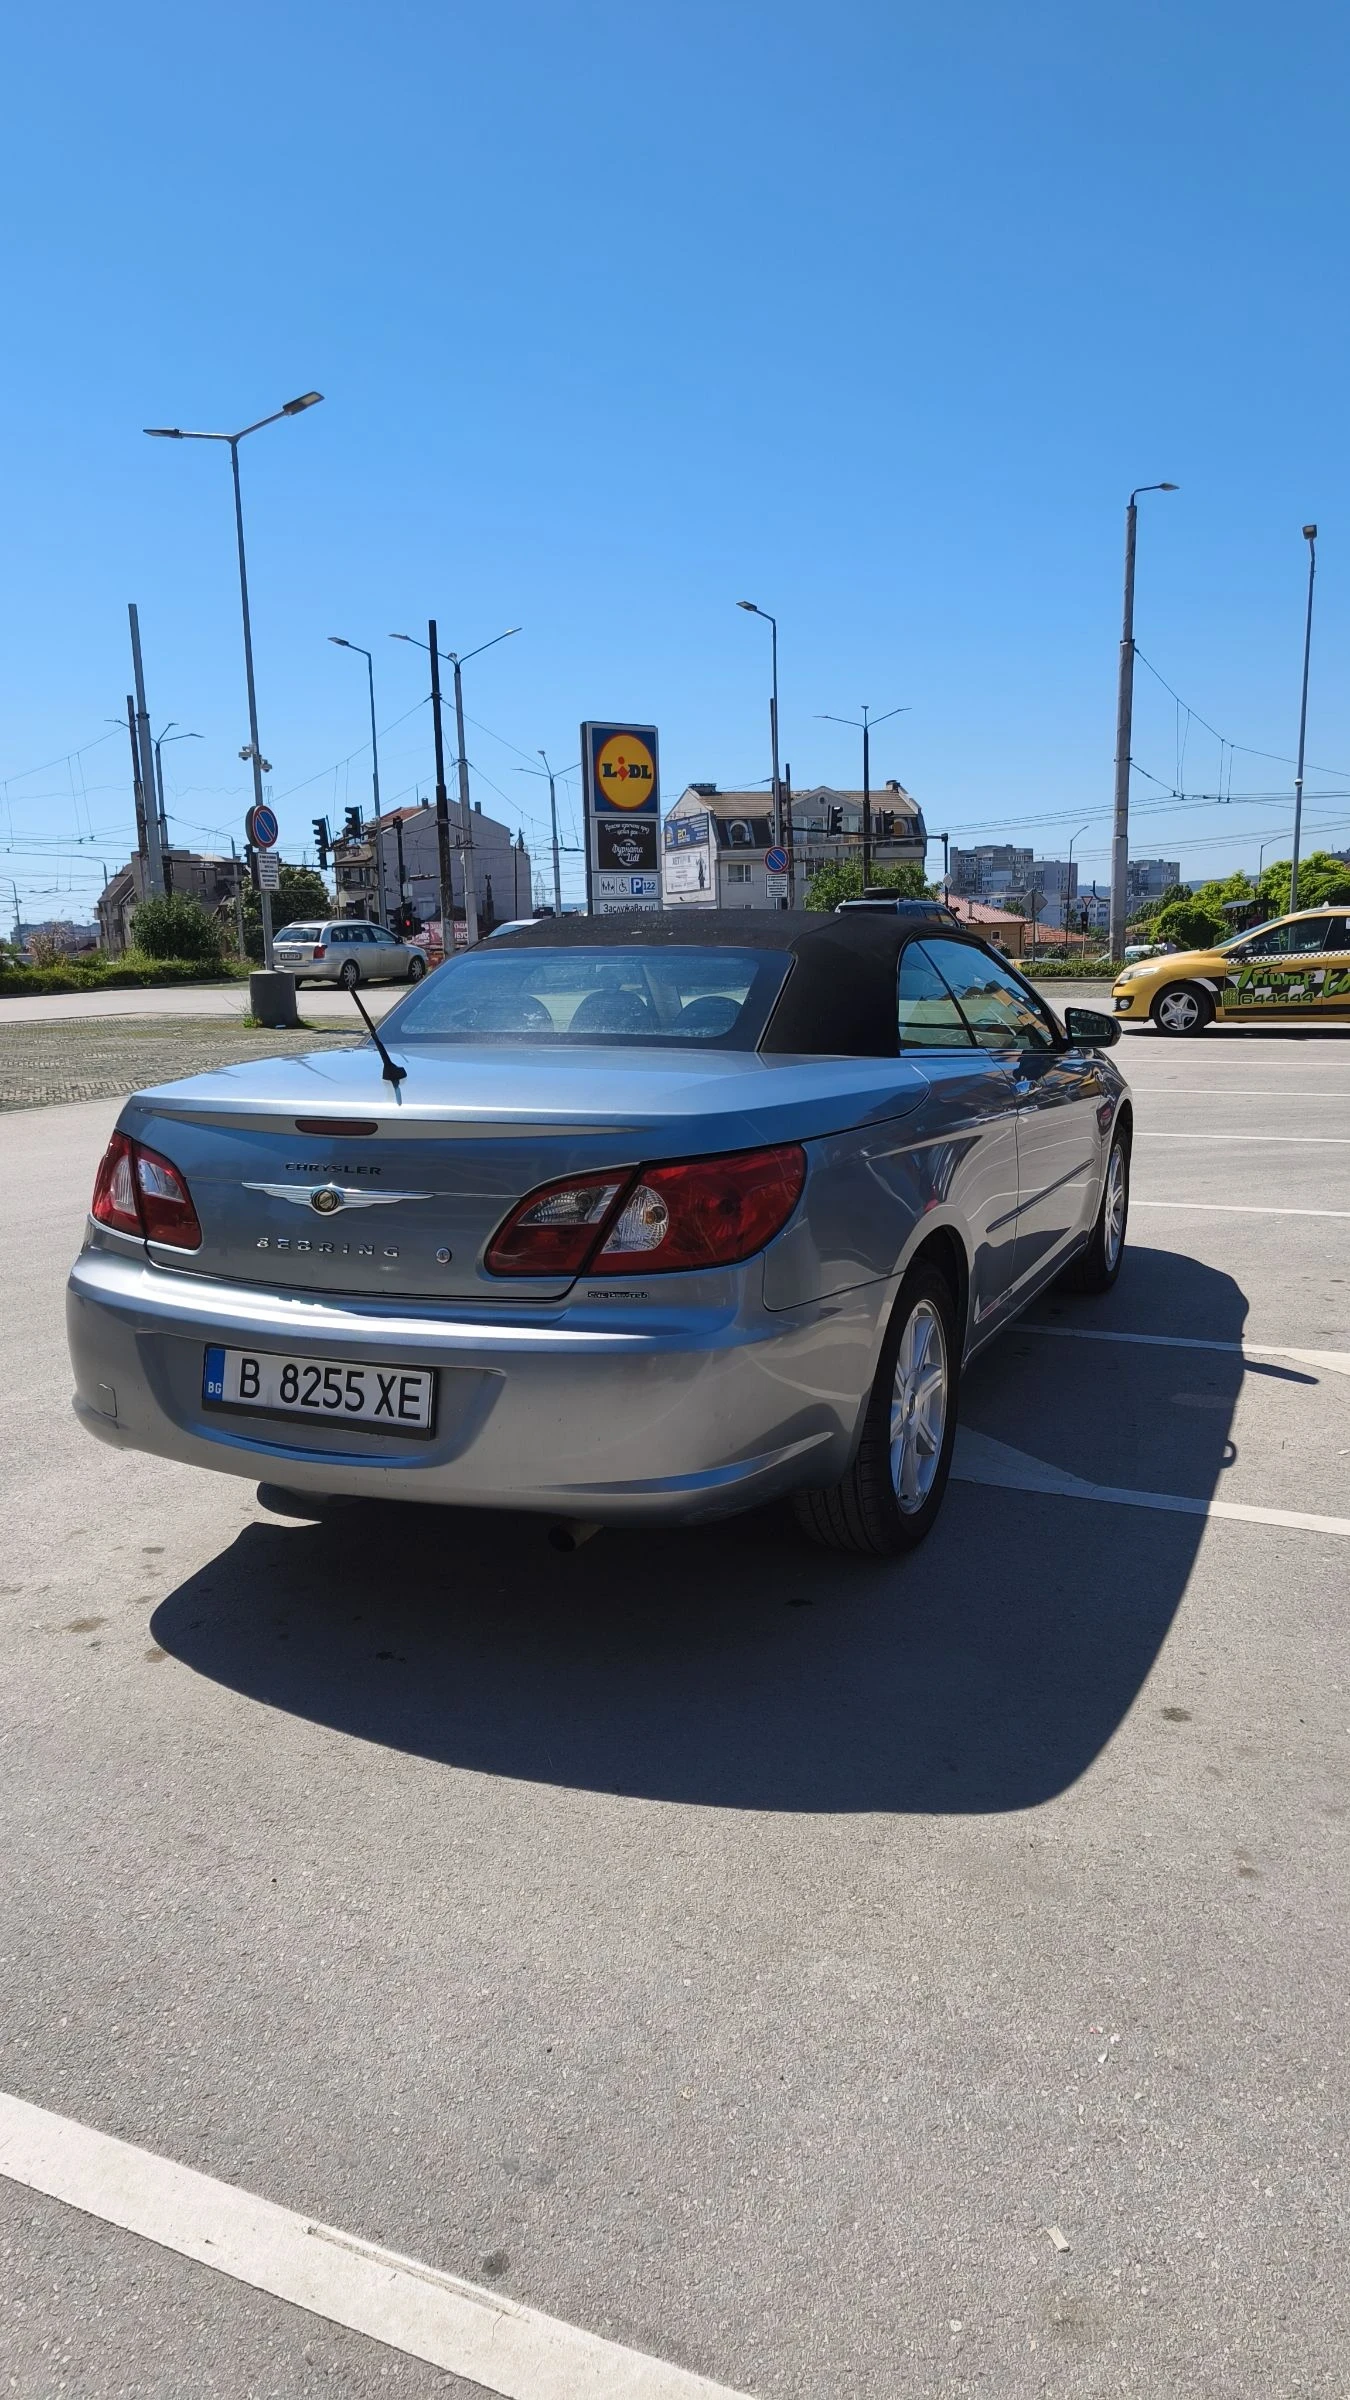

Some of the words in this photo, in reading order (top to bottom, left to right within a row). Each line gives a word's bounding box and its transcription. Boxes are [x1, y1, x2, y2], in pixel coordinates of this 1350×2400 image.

[643, 881, 656, 890] 122
[1227, 961, 1317, 990] Triumf
[1241, 992, 1314, 1005] 644444
[285, 1162, 383, 1176] CHRYSLER
[256, 1237, 400, 1258] SEBRING
[207, 1381, 223, 1394] BG
[279, 1363, 366, 1413] 8255
